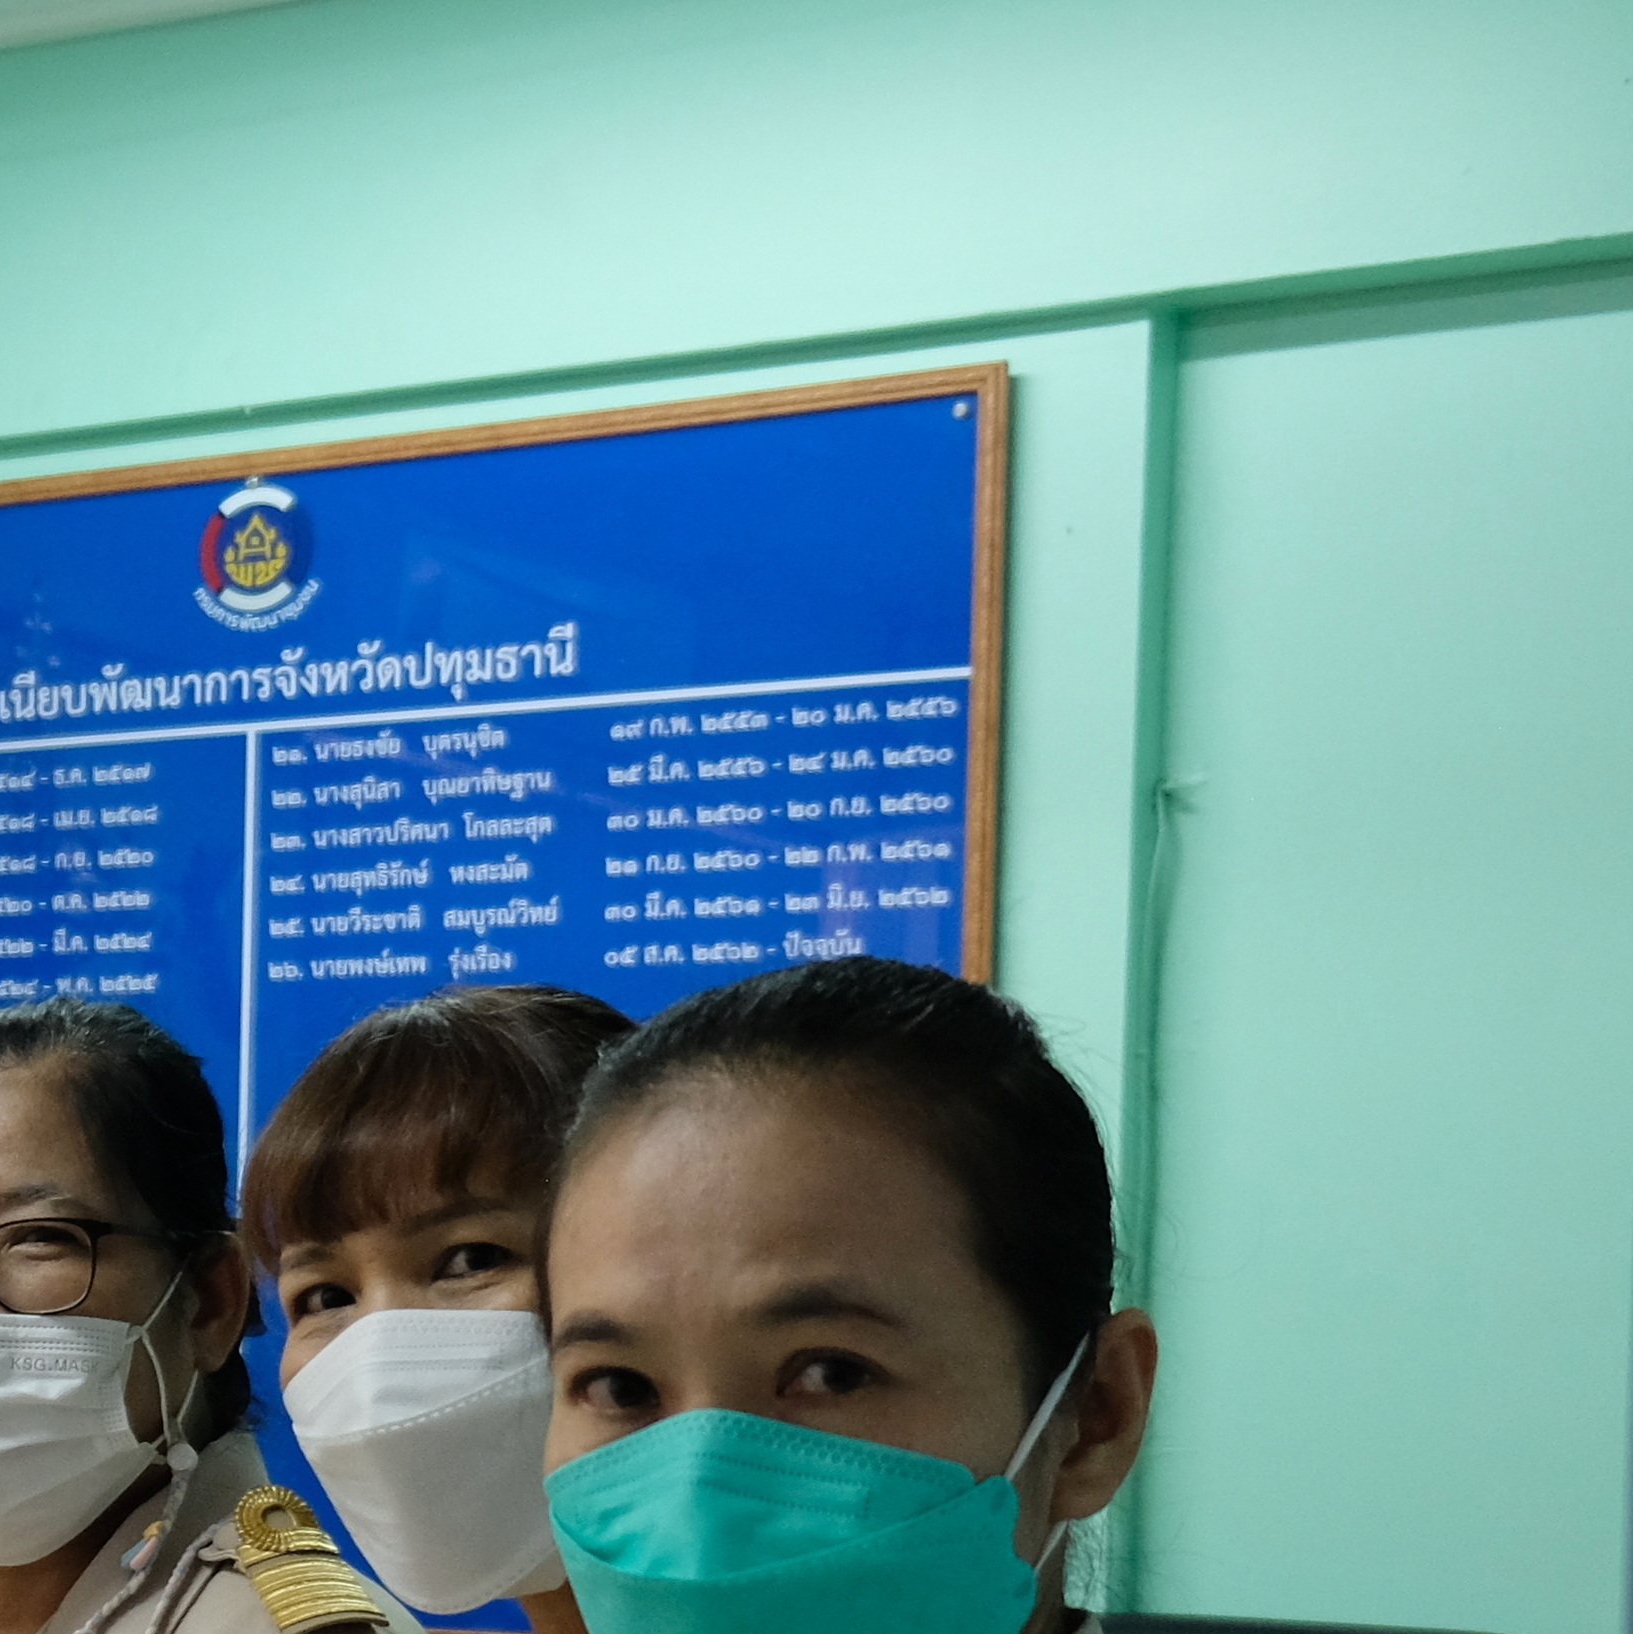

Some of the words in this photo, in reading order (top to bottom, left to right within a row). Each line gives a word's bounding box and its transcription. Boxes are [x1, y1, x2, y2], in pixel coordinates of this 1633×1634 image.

[792, 708, 827, 727] ๒๐
[272, 747, 307, 765] ๒๑.
[272, 790, 307, 808] ๒๒.
[788, 801, 823, 820] ๒๐
[271, 833, 306, 851] ๒๓.
[313, 817, 451, 849] นางสาวปริศนา
[311, 904, 424, 935] นายวีระชาติ
[443, 896, 559, 936] สมบูรณ์วิทย์
[268, 962, 303, 981] ๒๖.
[310, 949, 428, 979] นายพงษ์เทพ
[448, 944, 514, 980] รุ่งเรือง
[11, 1358, 98, 1373] KSG.MASK
